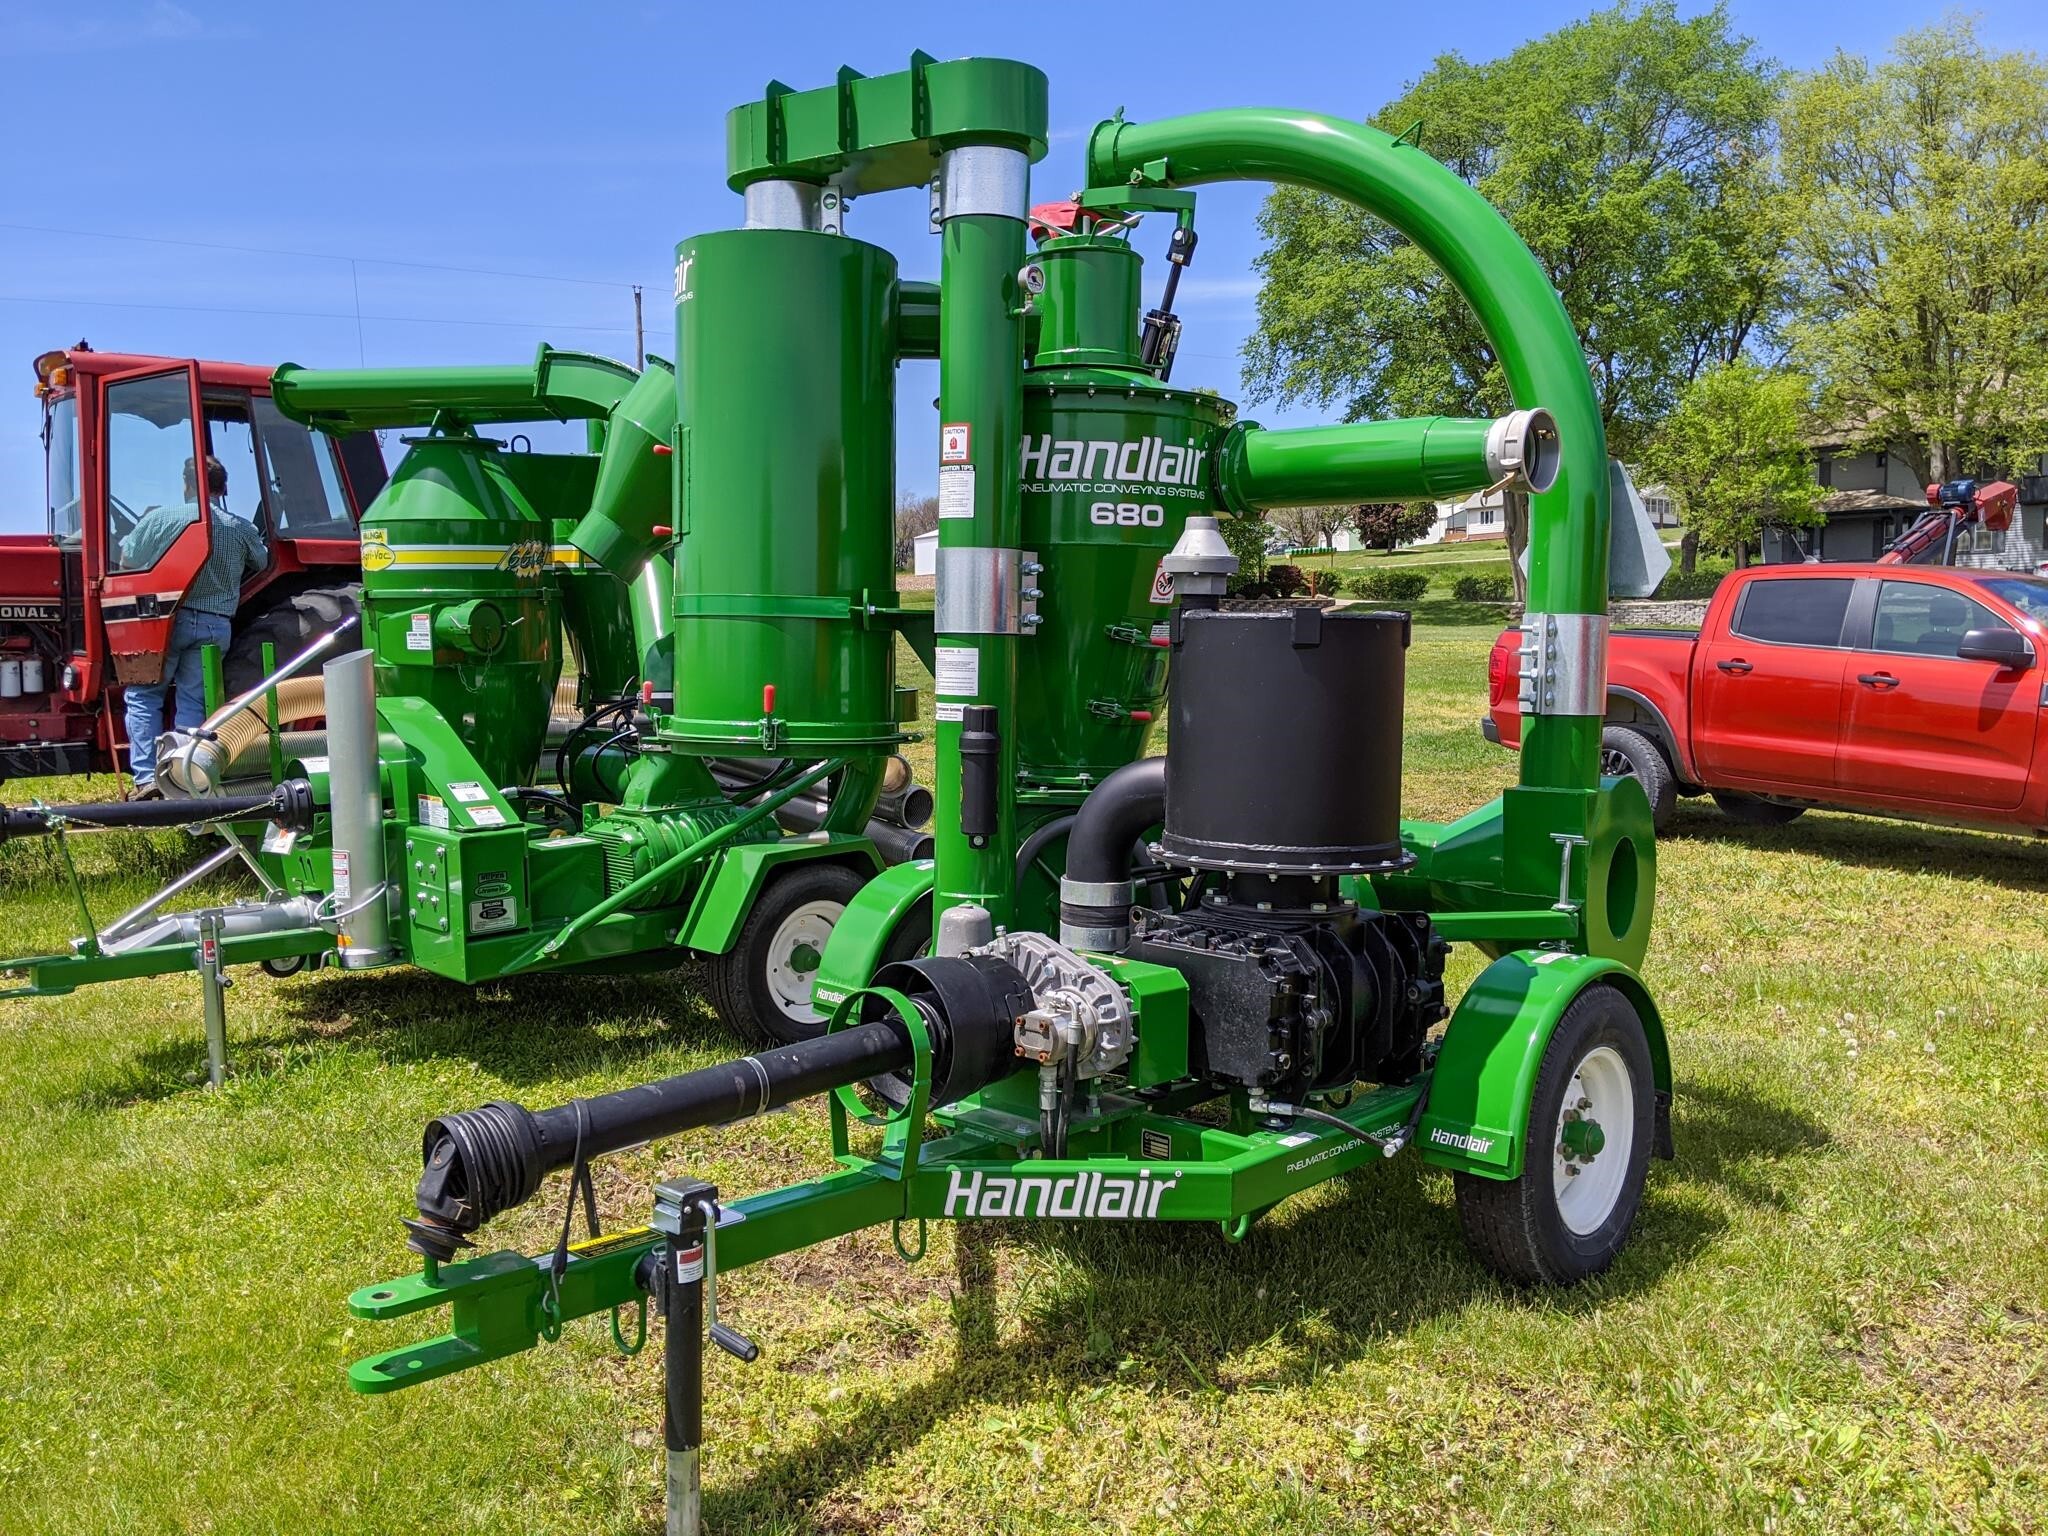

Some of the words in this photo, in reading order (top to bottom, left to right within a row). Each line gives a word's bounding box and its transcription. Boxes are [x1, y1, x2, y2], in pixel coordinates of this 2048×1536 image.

[1018, 433, 1206, 486] Handlair
[1019, 482, 1092, 494] PNEUMATIC
[1094, 482, 1167, 496] CONVEYING
[1168, 487, 1206, 500] SYSTEMS
[1090, 502, 1165, 528] 680
[0, 607, 49, 618] ONAL
[1430, 1127, 1494, 1153] Handlair
[1286, 1150, 1330, 1175] PNEUMATIC
[943, 1168, 1184, 1219] Handlair
